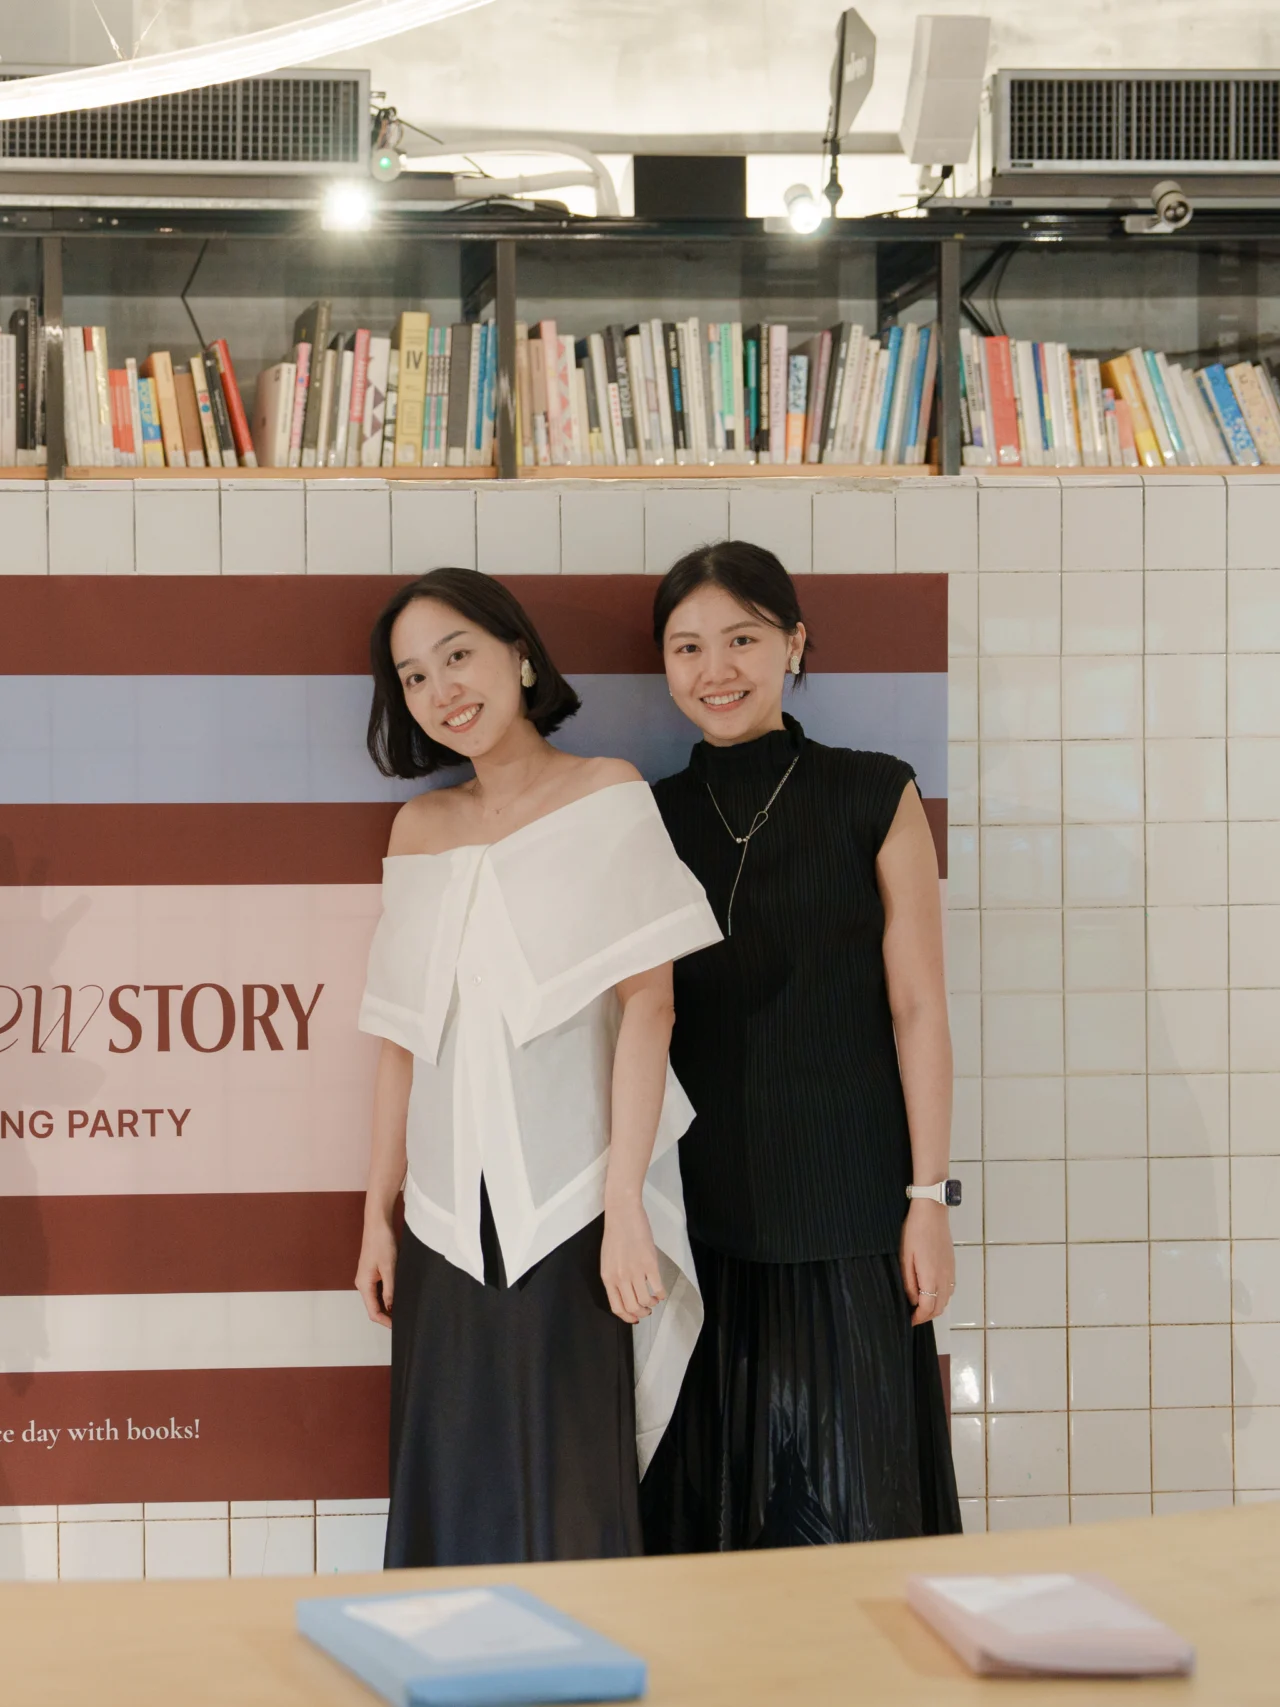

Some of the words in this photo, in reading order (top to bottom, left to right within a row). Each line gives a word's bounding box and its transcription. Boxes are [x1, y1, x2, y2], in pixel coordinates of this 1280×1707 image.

[68, 1108, 192, 1139] PARTY
[22, 1420, 61, 1449] day
[67, 1419, 119, 1441] with
[127, 1417, 200, 1440] books!
